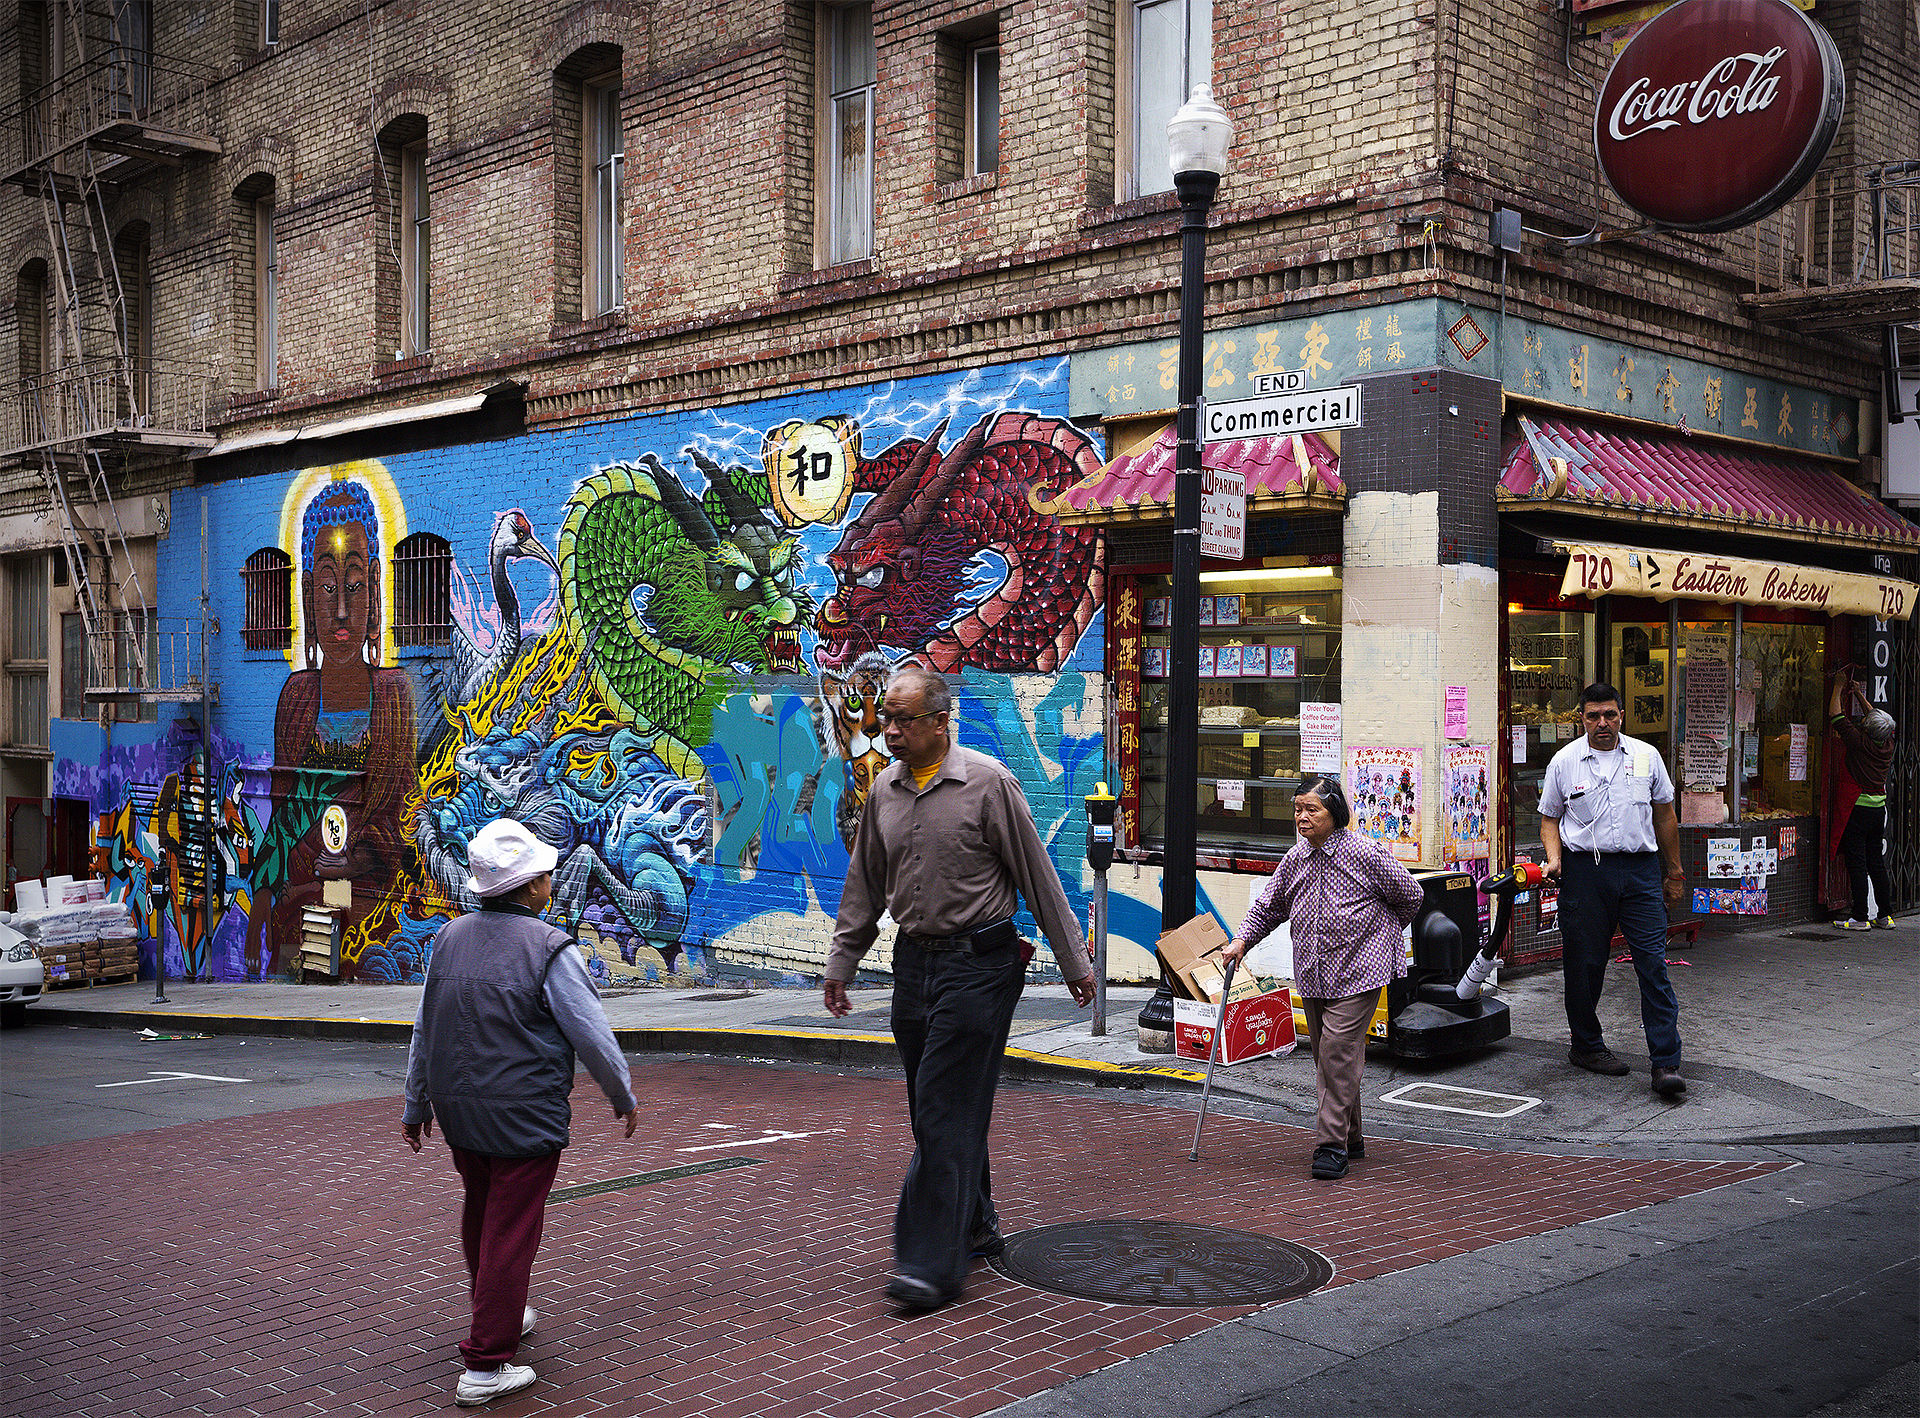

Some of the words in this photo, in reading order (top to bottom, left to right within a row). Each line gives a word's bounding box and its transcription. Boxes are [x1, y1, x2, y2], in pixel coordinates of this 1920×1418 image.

[1609, 46, 1787, 141] Coca-Cola
[1260, 374, 1299, 392] END
[1211, 395, 1351, 434] Commercial
[787, 445, 833, 496] 和
[1214, 474, 1244, 498] PARKING
[1201, 520, 1214, 536] TUE
[1214, 529, 1223, 538] AND
[1223, 524, 1241, 541] THUR
[1201, 542, 1217, 553] STREET
[1217, 545, 1241, 556] CLEANING
[1572, 553, 1614, 590] 720
[1874, 554, 1891, 574] The
[1671, 557, 1749, 597] Eastern
[1761, 567, 1829, 609] Bakery
[1878, 584, 1904, 616] 720
[1540, 673, 1577, 691] BAKERY
[1306, 704, 1322, 712] Order
[1320, 713, 1340, 721] Crunch
[1306, 722, 1319, 730] Cake
[328, 818, 341, 847] 智
[1449, 879, 1467, 888] TONY
